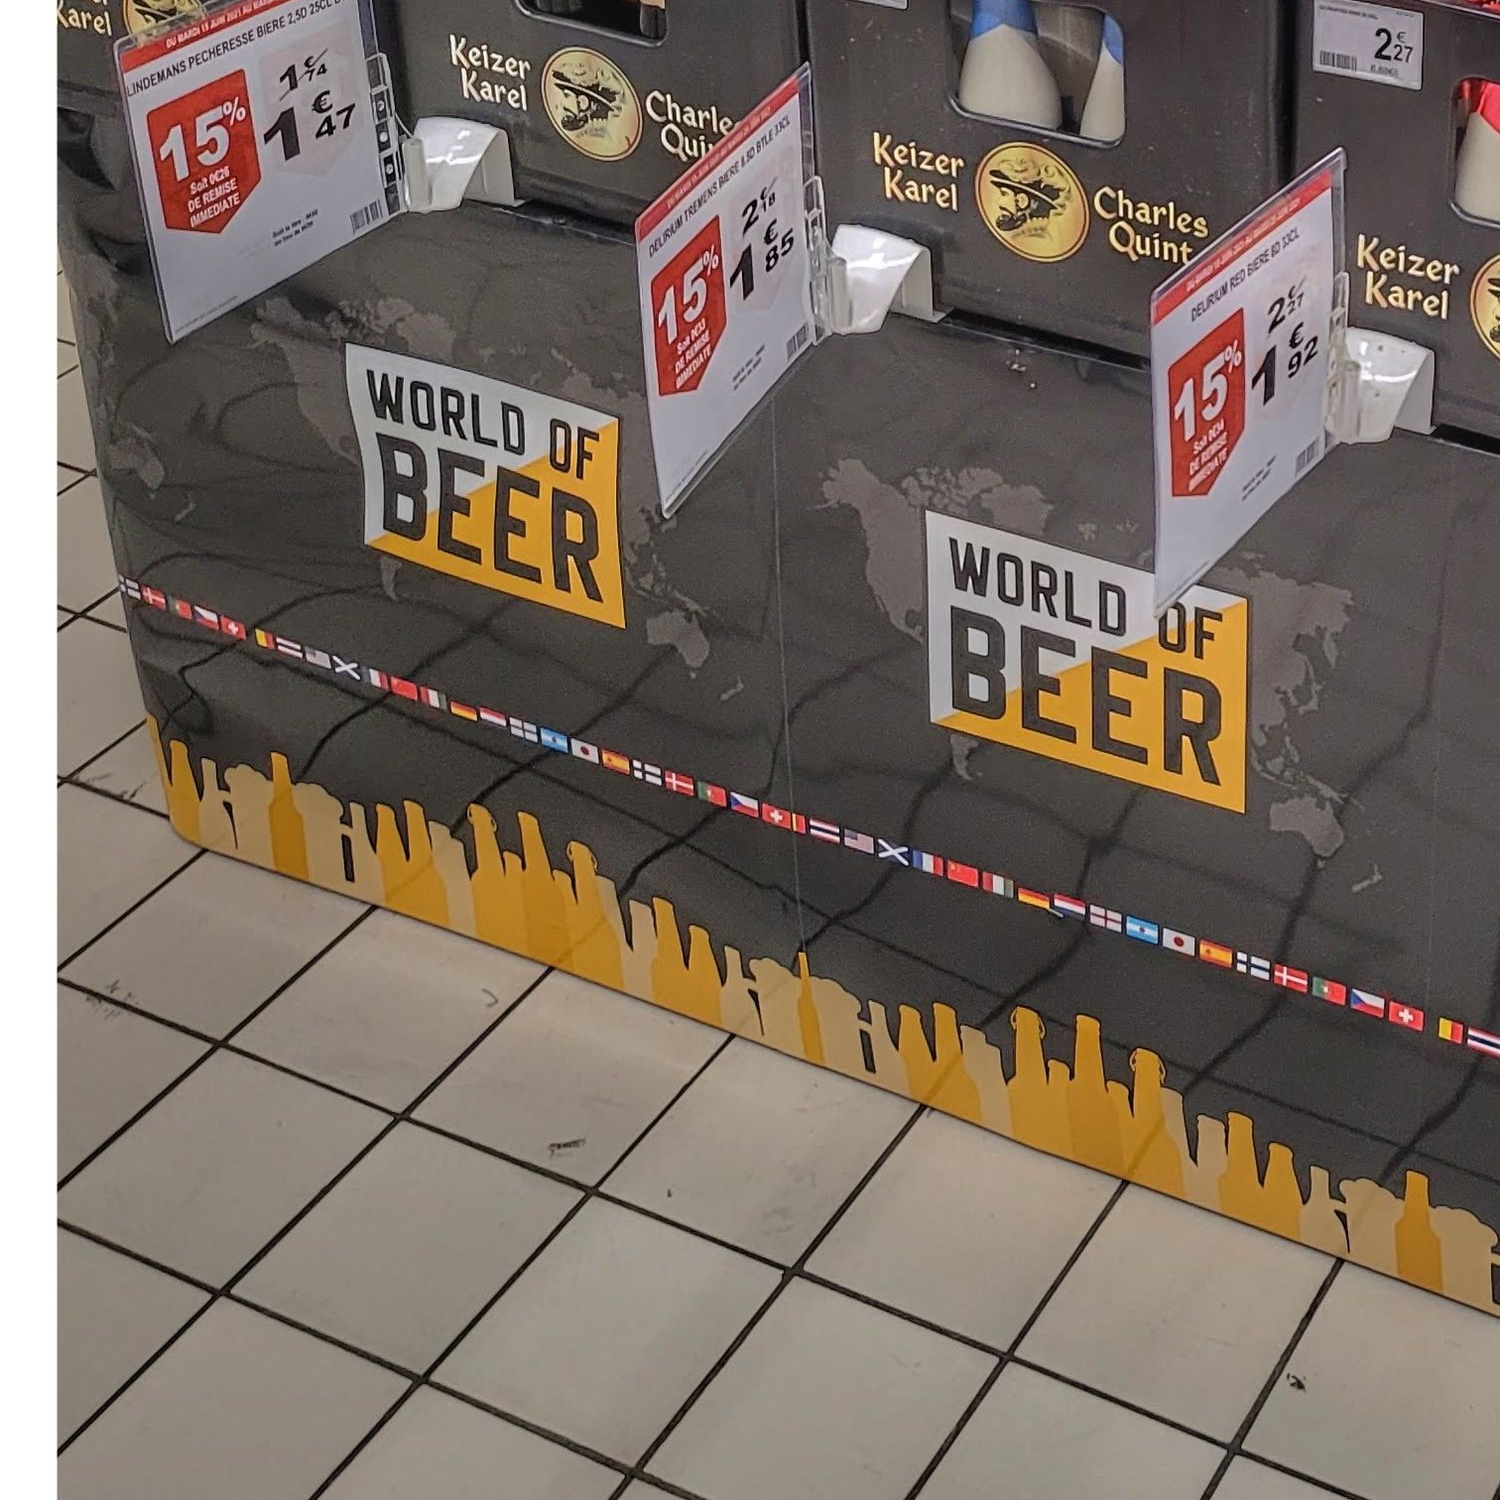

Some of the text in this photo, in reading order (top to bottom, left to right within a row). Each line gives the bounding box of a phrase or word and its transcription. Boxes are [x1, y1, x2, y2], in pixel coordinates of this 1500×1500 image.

[127, 61, 187, 97] LINDEMANS
[188, 28, 256, 70] PECHERESSE
[256, 15, 287, 39] BIERE
[449, 35, 531, 79] Keizer
[1374, 27, 1414, 63] 2€27
[461, 67, 529, 112] Karel
[645, 90, 740, 137] Charle
[159, 96, 247, 182] 15%
[871, 132, 965, 179] Keizer
[187, 177, 238, 213] DE REMISE
[189, 193, 241, 229] IMMEDIATE
[649, 130, 774, 258] DELIRIUM TREMENS BIERE BTLE
[884, 166, 960, 213] Karel
[1093, 185, 1209, 238] Charles
[1108, 221, 1194, 265] Quint
[1356, 233, 1461, 286] Keizer
[658, 243, 719, 345] 15%
[1190, 280, 1229, 323] DELIRIUM
[1229, 267, 1245, 291] RED
[1246, 250, 1270, 278] BIERE
[1365, 271, 1449, 319] Karel
[1174, 339, 1242, 442] 15%
[366, 370, 600, 480] WORLD OF
[376, 432, 604, 604] BEER
[950, 537, 1224, 659] WORLD OF
[950, 605, 1223, 787] BEER
